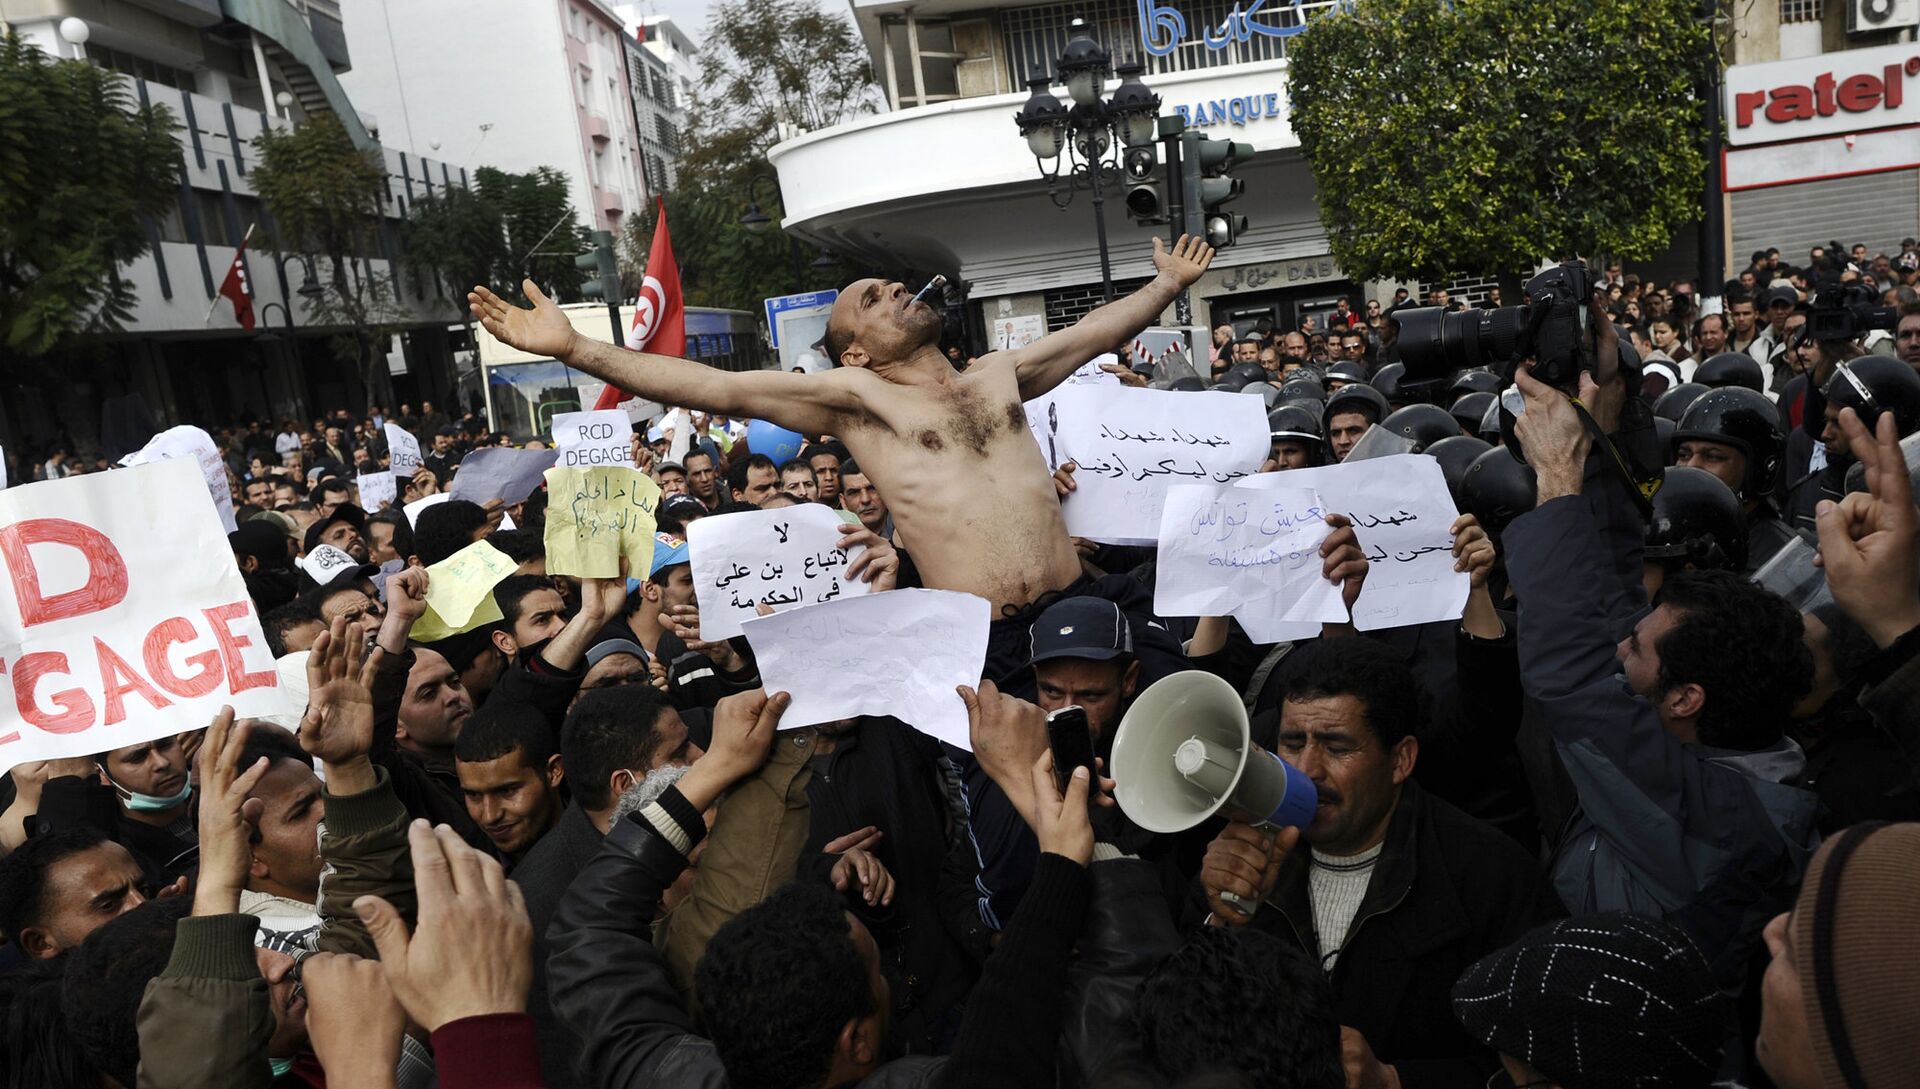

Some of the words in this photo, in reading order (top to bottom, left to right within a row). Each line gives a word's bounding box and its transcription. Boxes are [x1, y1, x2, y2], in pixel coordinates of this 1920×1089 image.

[1736, 63, 1903, 129] ratel
[1174, 93, 1280, 127] BANQUE
[1286, 260, 1332, 281] DAB
[579, 423, 613, 441] RCD
[1101, 423, 1165, 442] شهداء
[1172, 428, 1230, 446] شهداء
[393, 453, 421, 467] DEG
[566, 445, 631, 466] DEGAGE
[1070, 453, 1128, 479] أوفيا
[774, 522, 789, 544] لا
[715, 563, 751, 591] علي
[760, 561, 783, 580] بن
